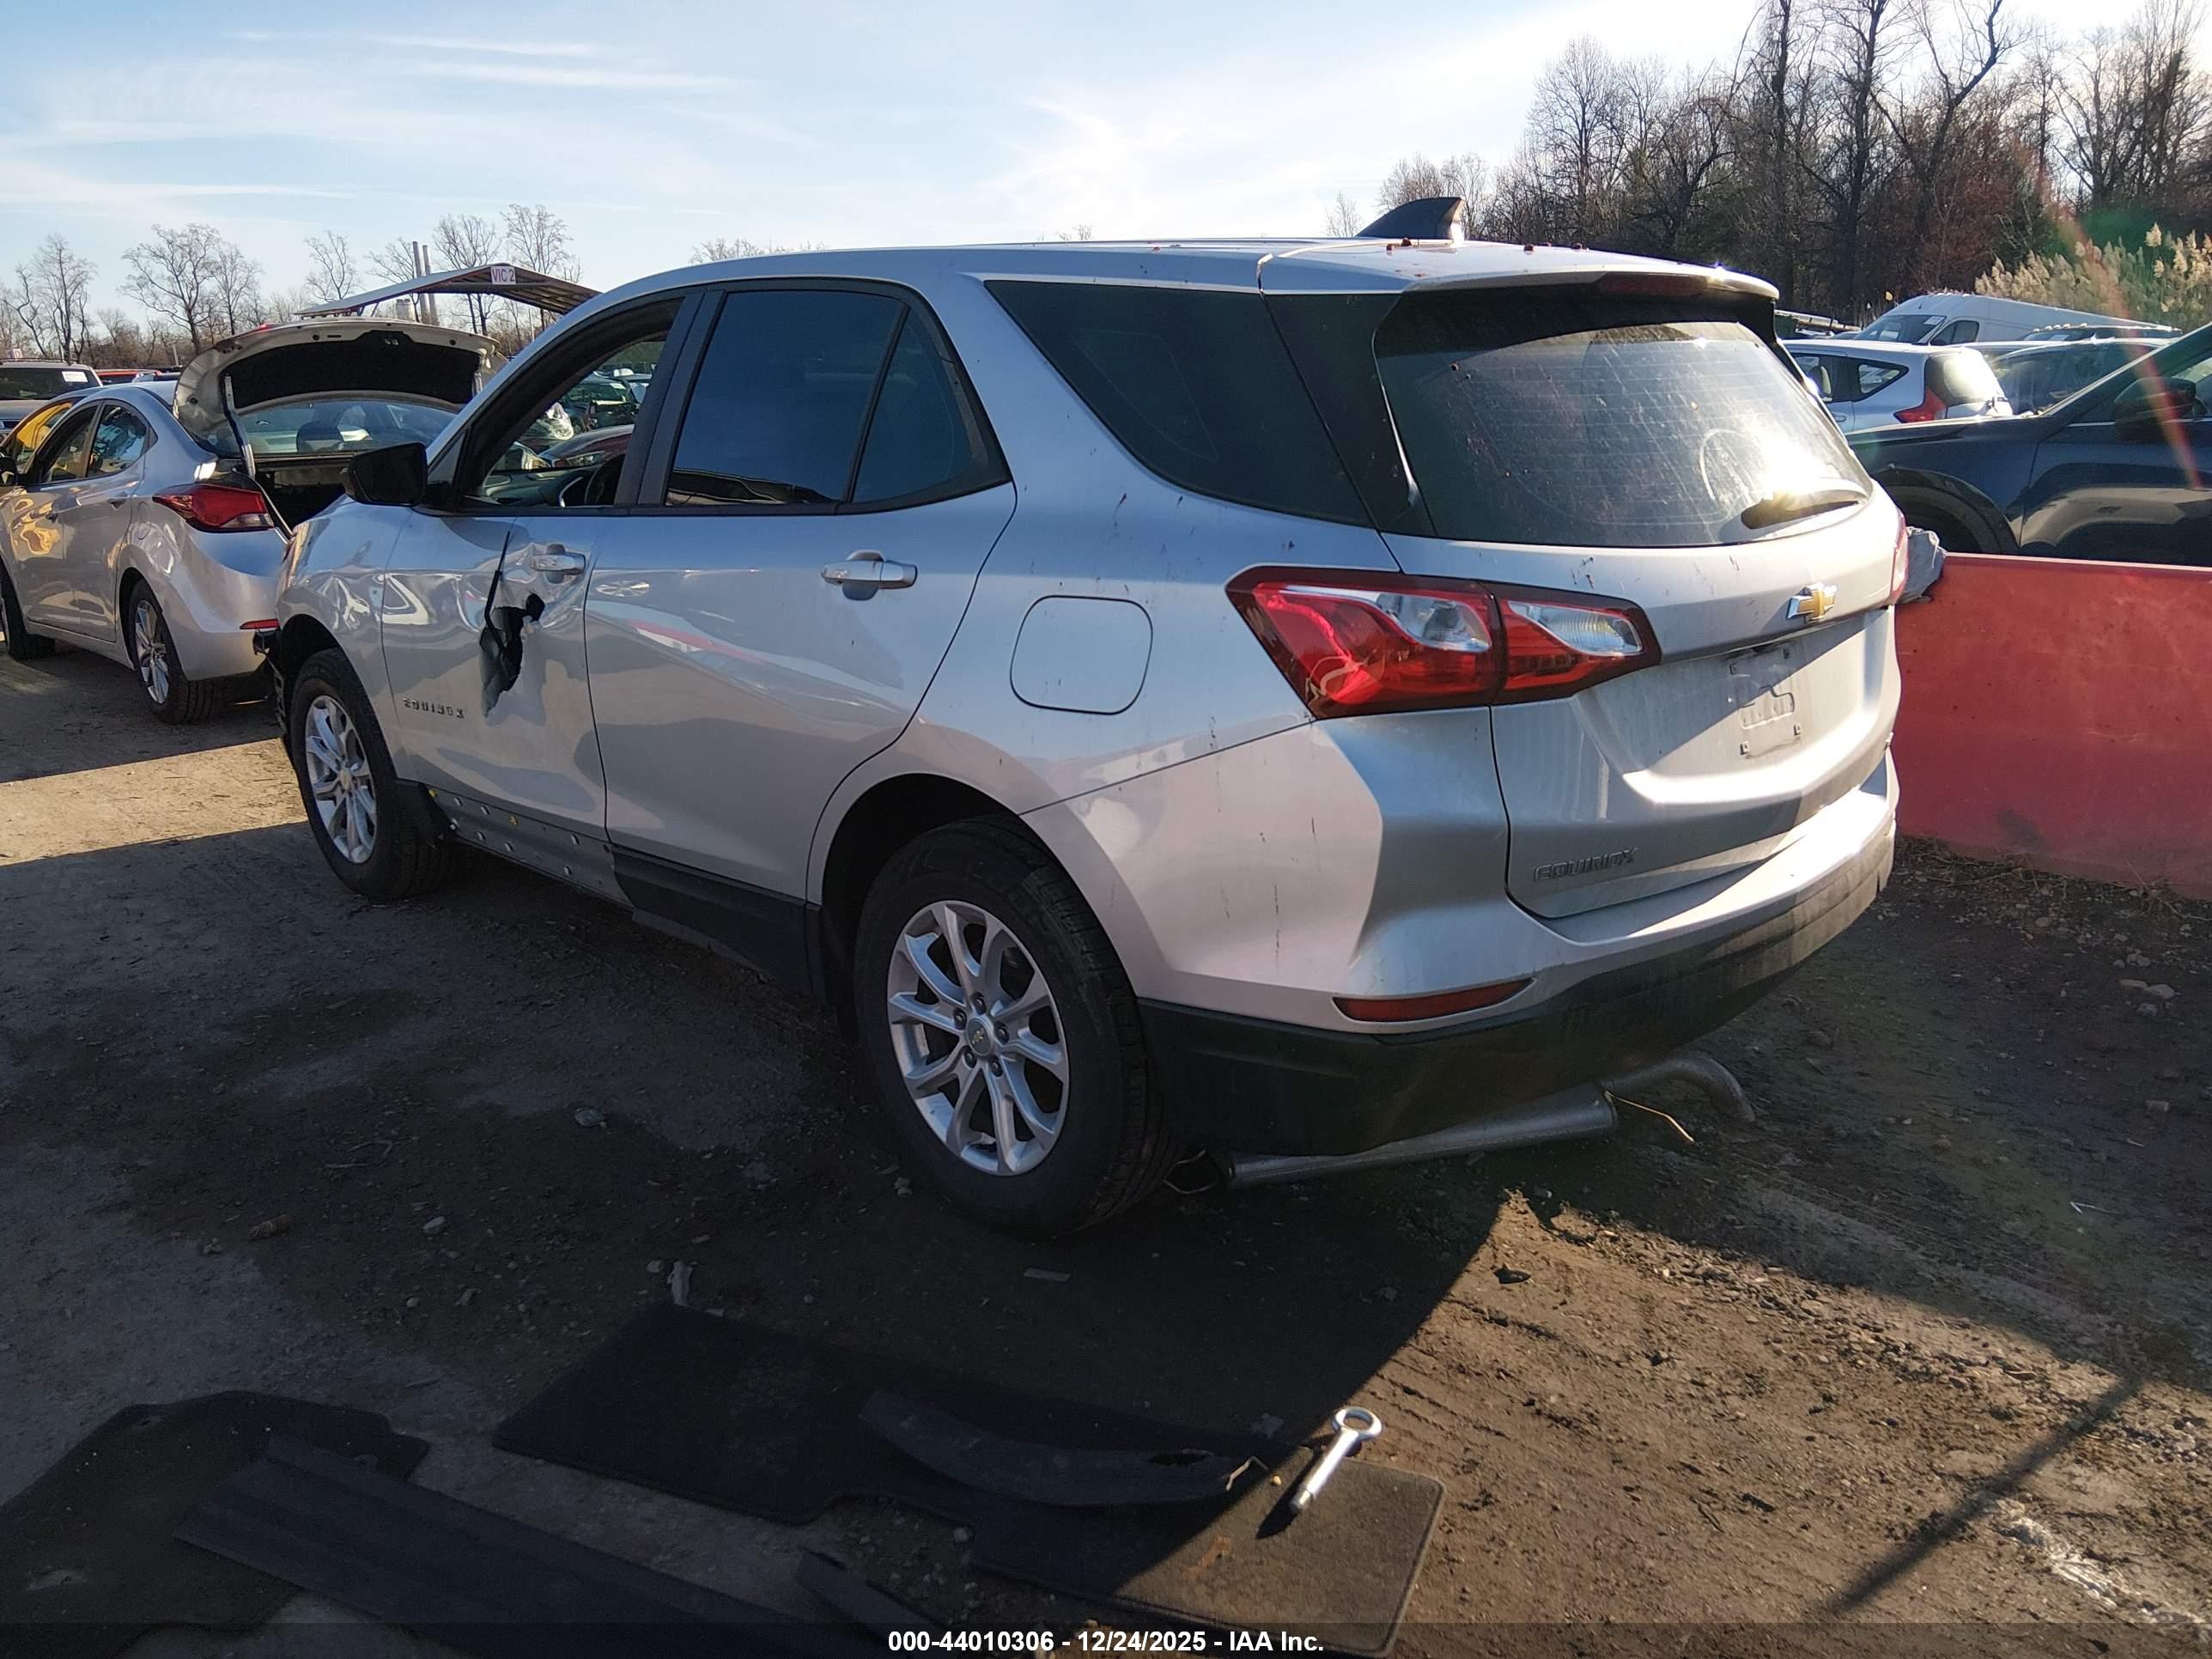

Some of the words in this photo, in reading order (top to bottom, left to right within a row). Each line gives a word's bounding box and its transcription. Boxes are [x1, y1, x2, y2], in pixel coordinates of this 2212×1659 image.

[492, 268, 507, 283] VIC
[508, 269, 515, 283] 2
[402, 696, 465, 719] EQUINOX
[1533, 847, 1638, 882] EQUINOX
